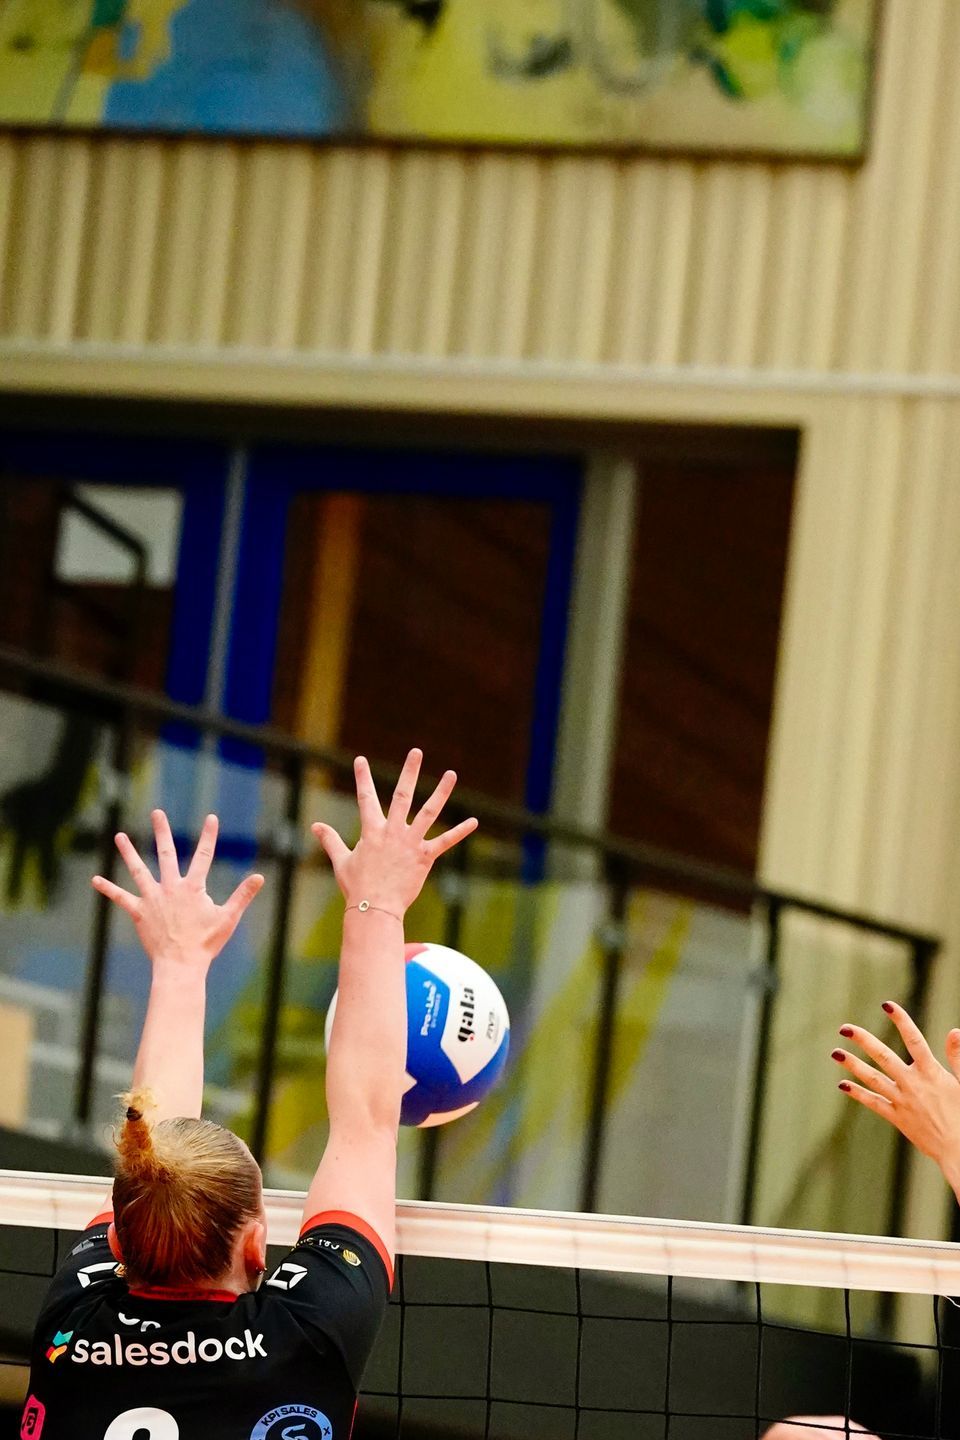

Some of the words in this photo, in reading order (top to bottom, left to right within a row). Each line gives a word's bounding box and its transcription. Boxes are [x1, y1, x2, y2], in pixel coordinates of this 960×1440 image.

[458, 987, 475, 1042] gala
[71, 1329, 267, 1367] salesdock
[260, 1409, 281, 1427] KPI
[280, 1406, 319, 1419] SALES
